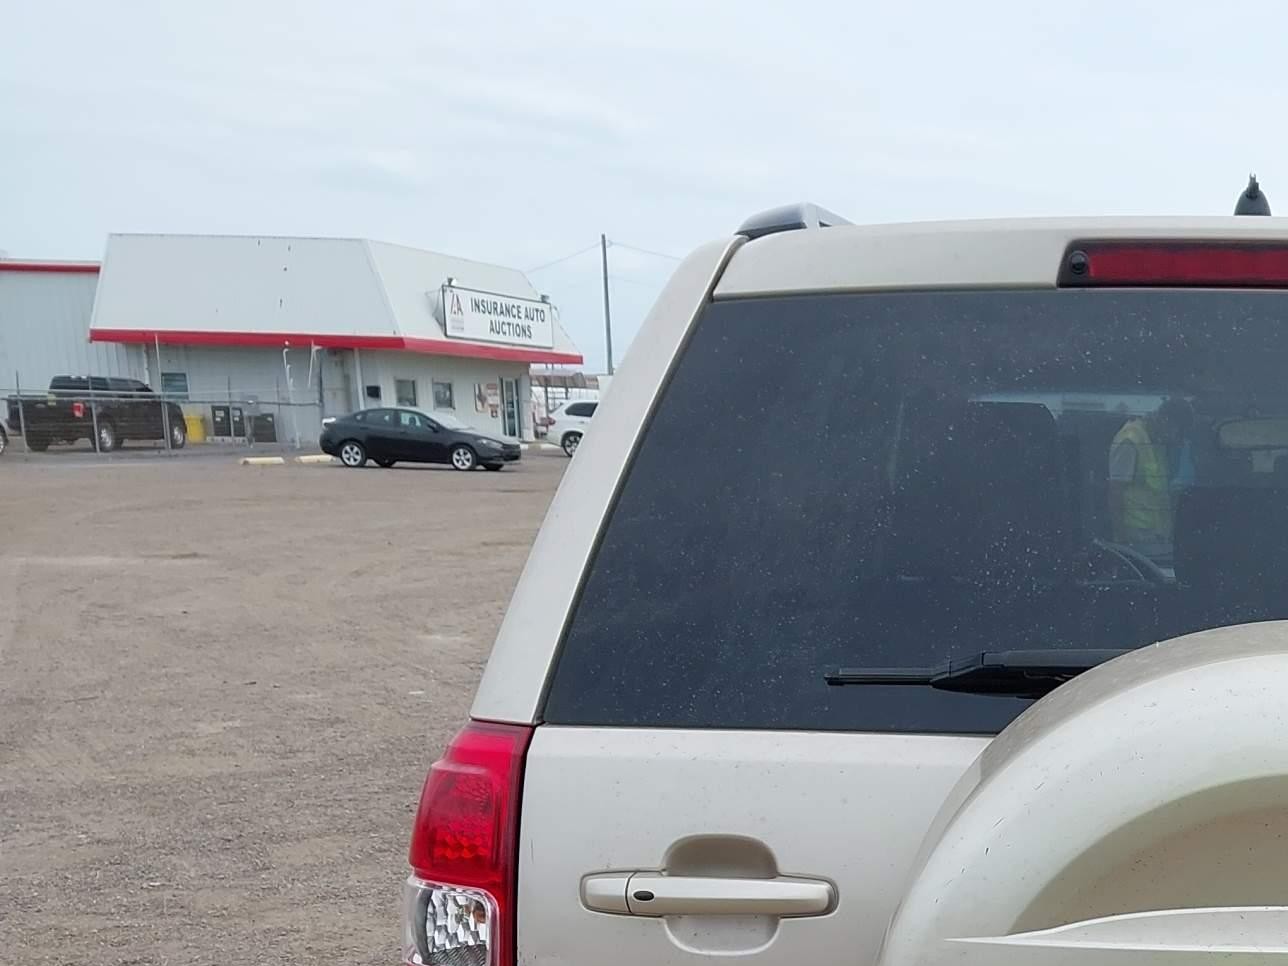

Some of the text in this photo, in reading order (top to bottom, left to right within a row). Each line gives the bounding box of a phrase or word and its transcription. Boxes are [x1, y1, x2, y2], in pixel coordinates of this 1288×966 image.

[471, 297, 546, 323] INSURANCE AUTO
[489, 320, 533, 339] AUCTIONS
